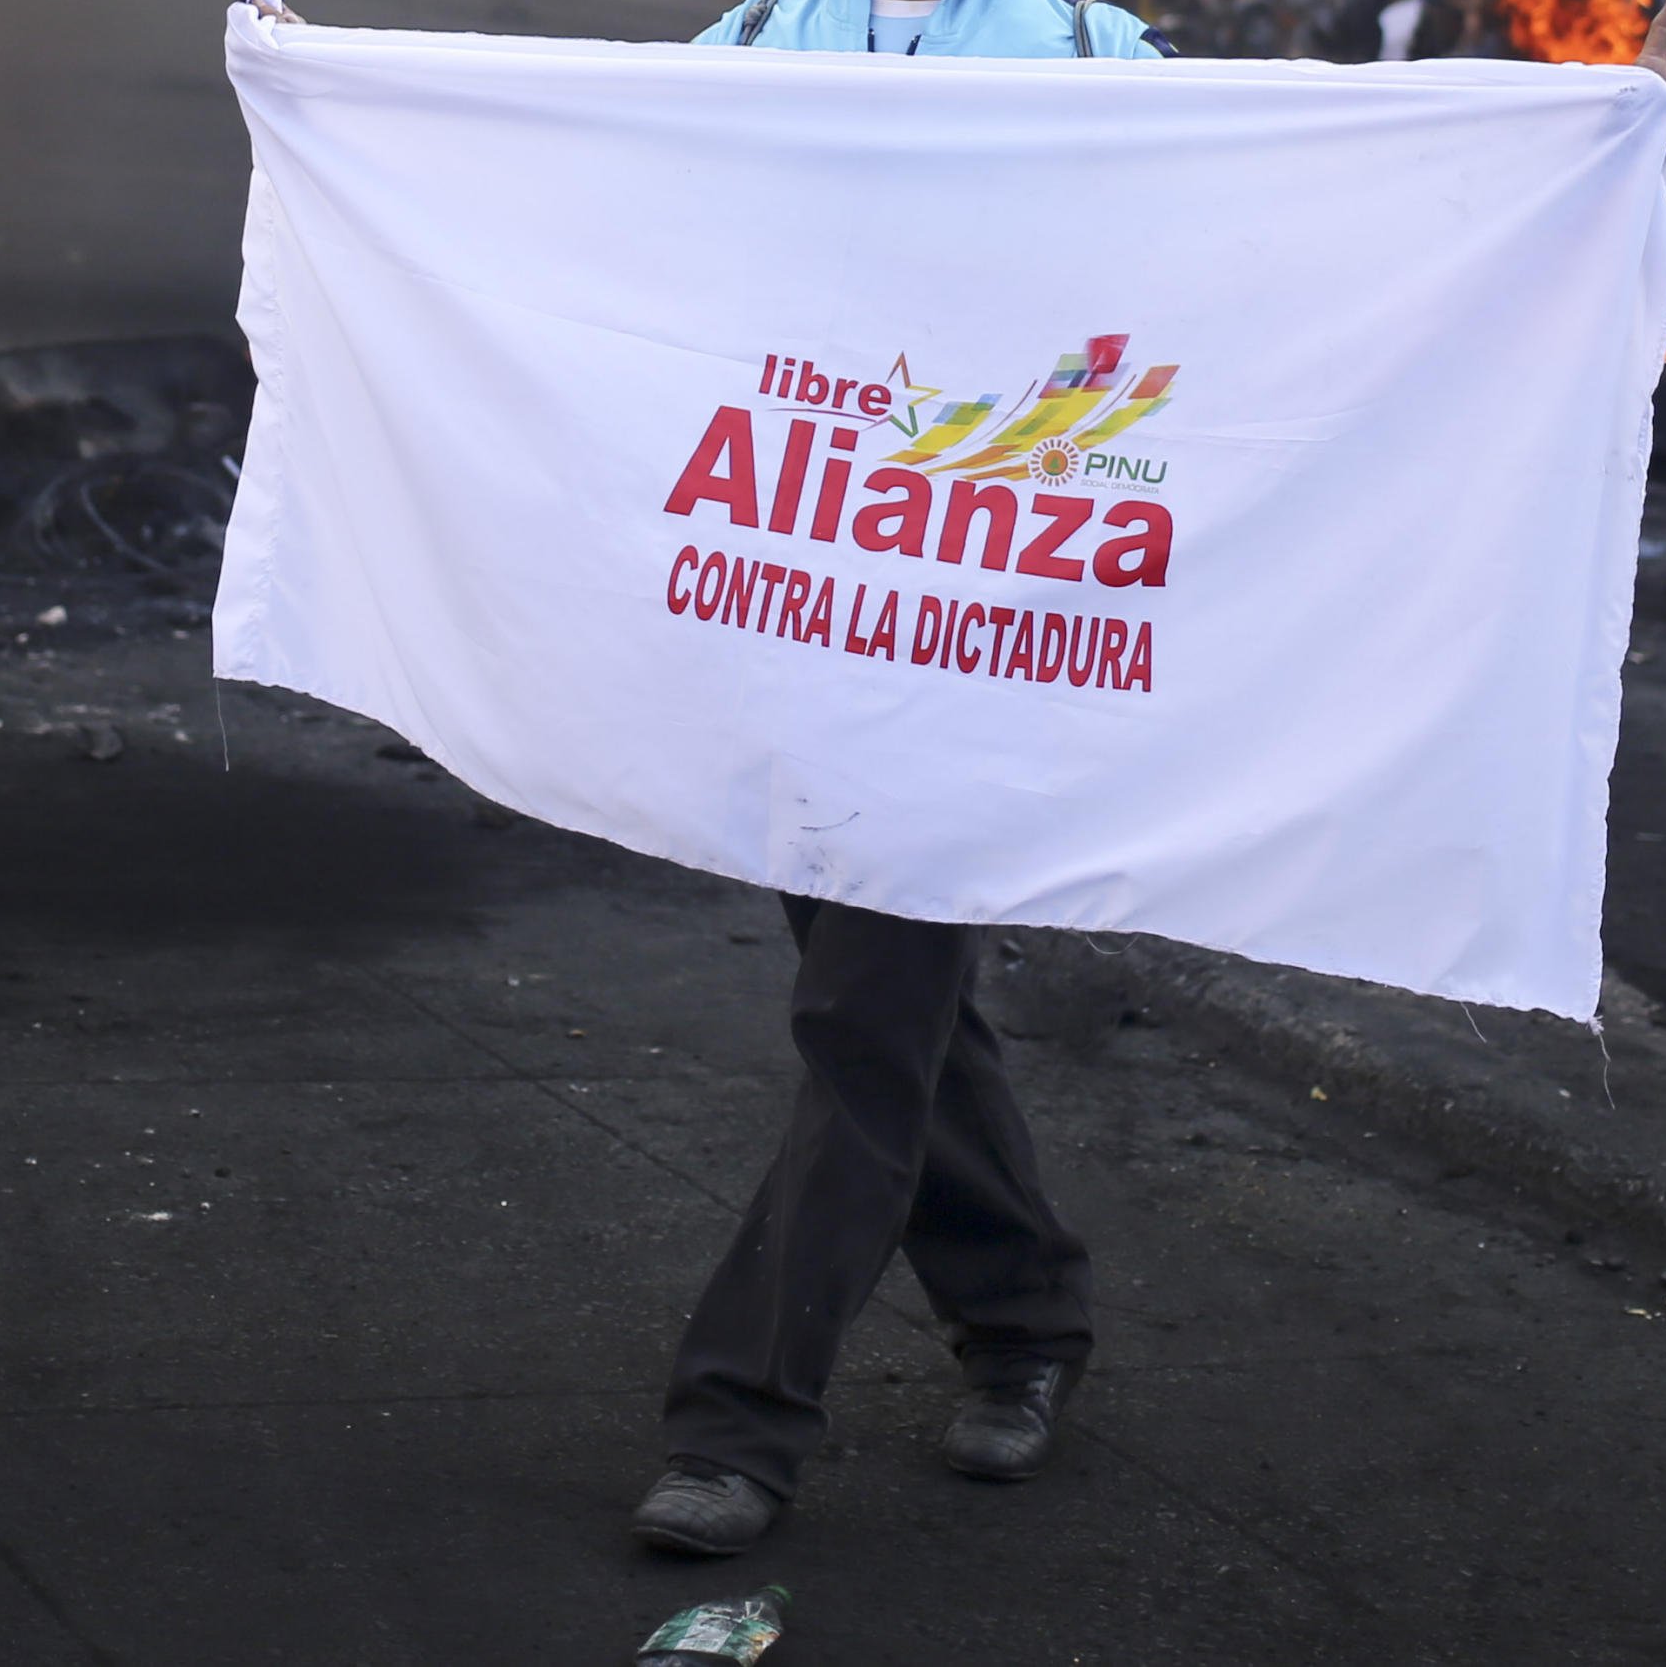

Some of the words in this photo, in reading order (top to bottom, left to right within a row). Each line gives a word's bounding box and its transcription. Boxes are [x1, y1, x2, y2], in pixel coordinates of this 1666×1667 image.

[759, 354, 892, 416] libre
[664, 405, 1173, 587] Alianza
[1084, 453, 1168, 483] PINU
[667, 545, 835, 647] CONTRA
[844, 583, 899, 661] LA
[911, 595, 1152, 692] DICTADURA
